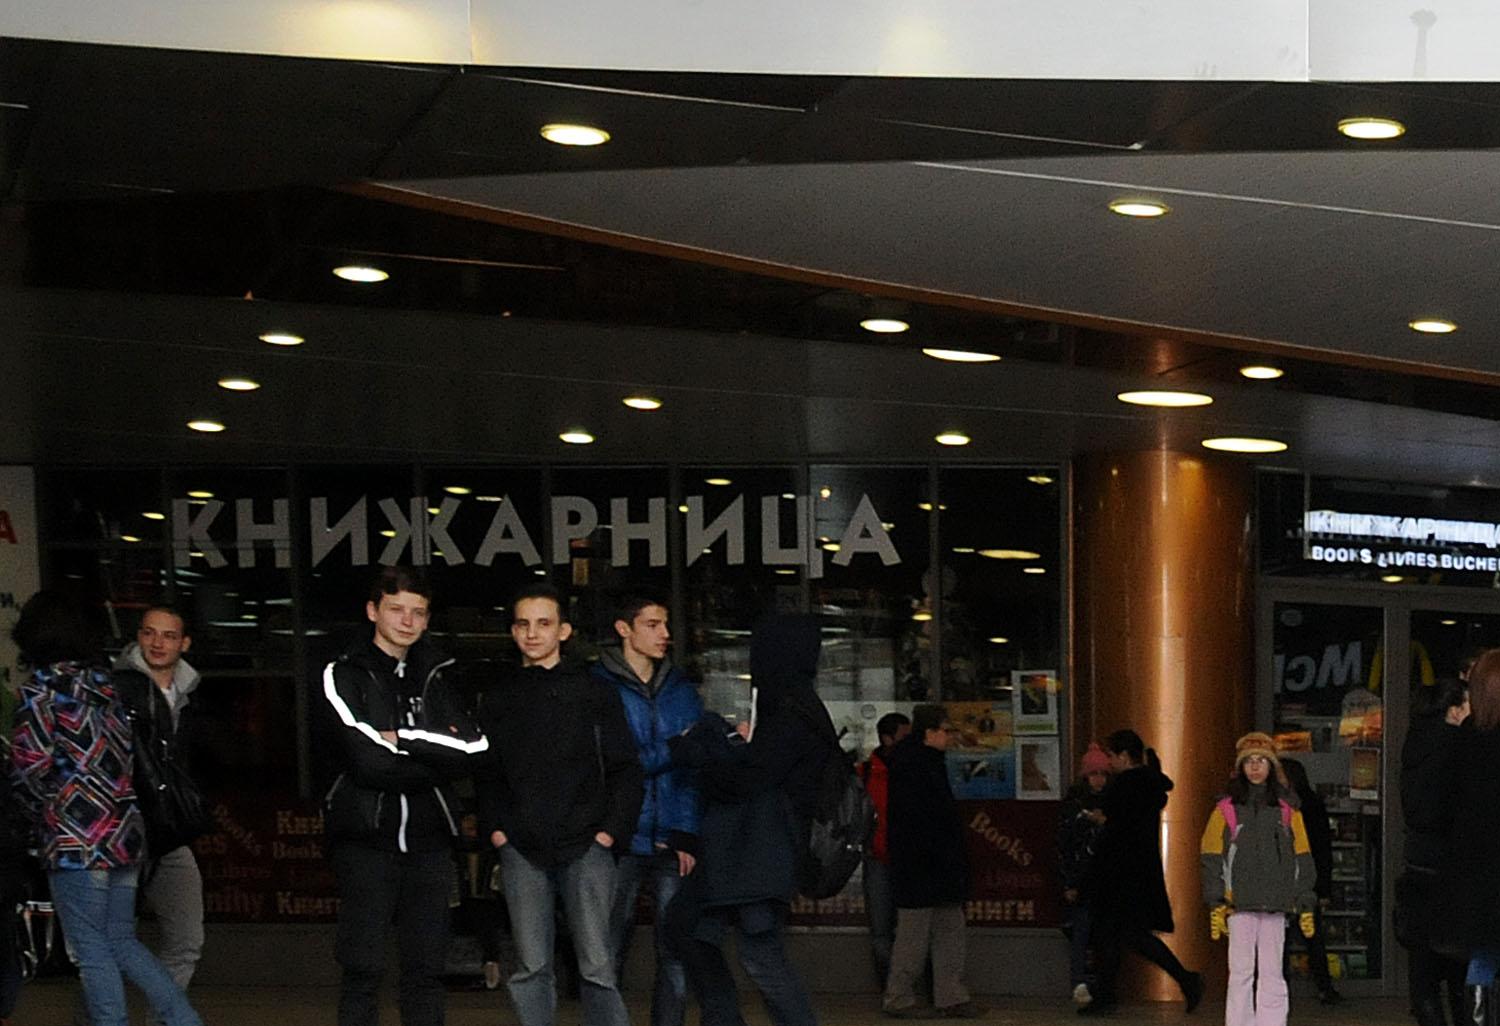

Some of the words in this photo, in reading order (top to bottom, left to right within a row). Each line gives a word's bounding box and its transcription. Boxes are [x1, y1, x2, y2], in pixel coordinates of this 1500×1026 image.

[173, 494, 901, 578] КНИЖАРНИЦА
[1312, 546, 1371, 563] BOOKS
[968, 811, 1034, 868] Books
[966, 899, 1036, 921] ниги
